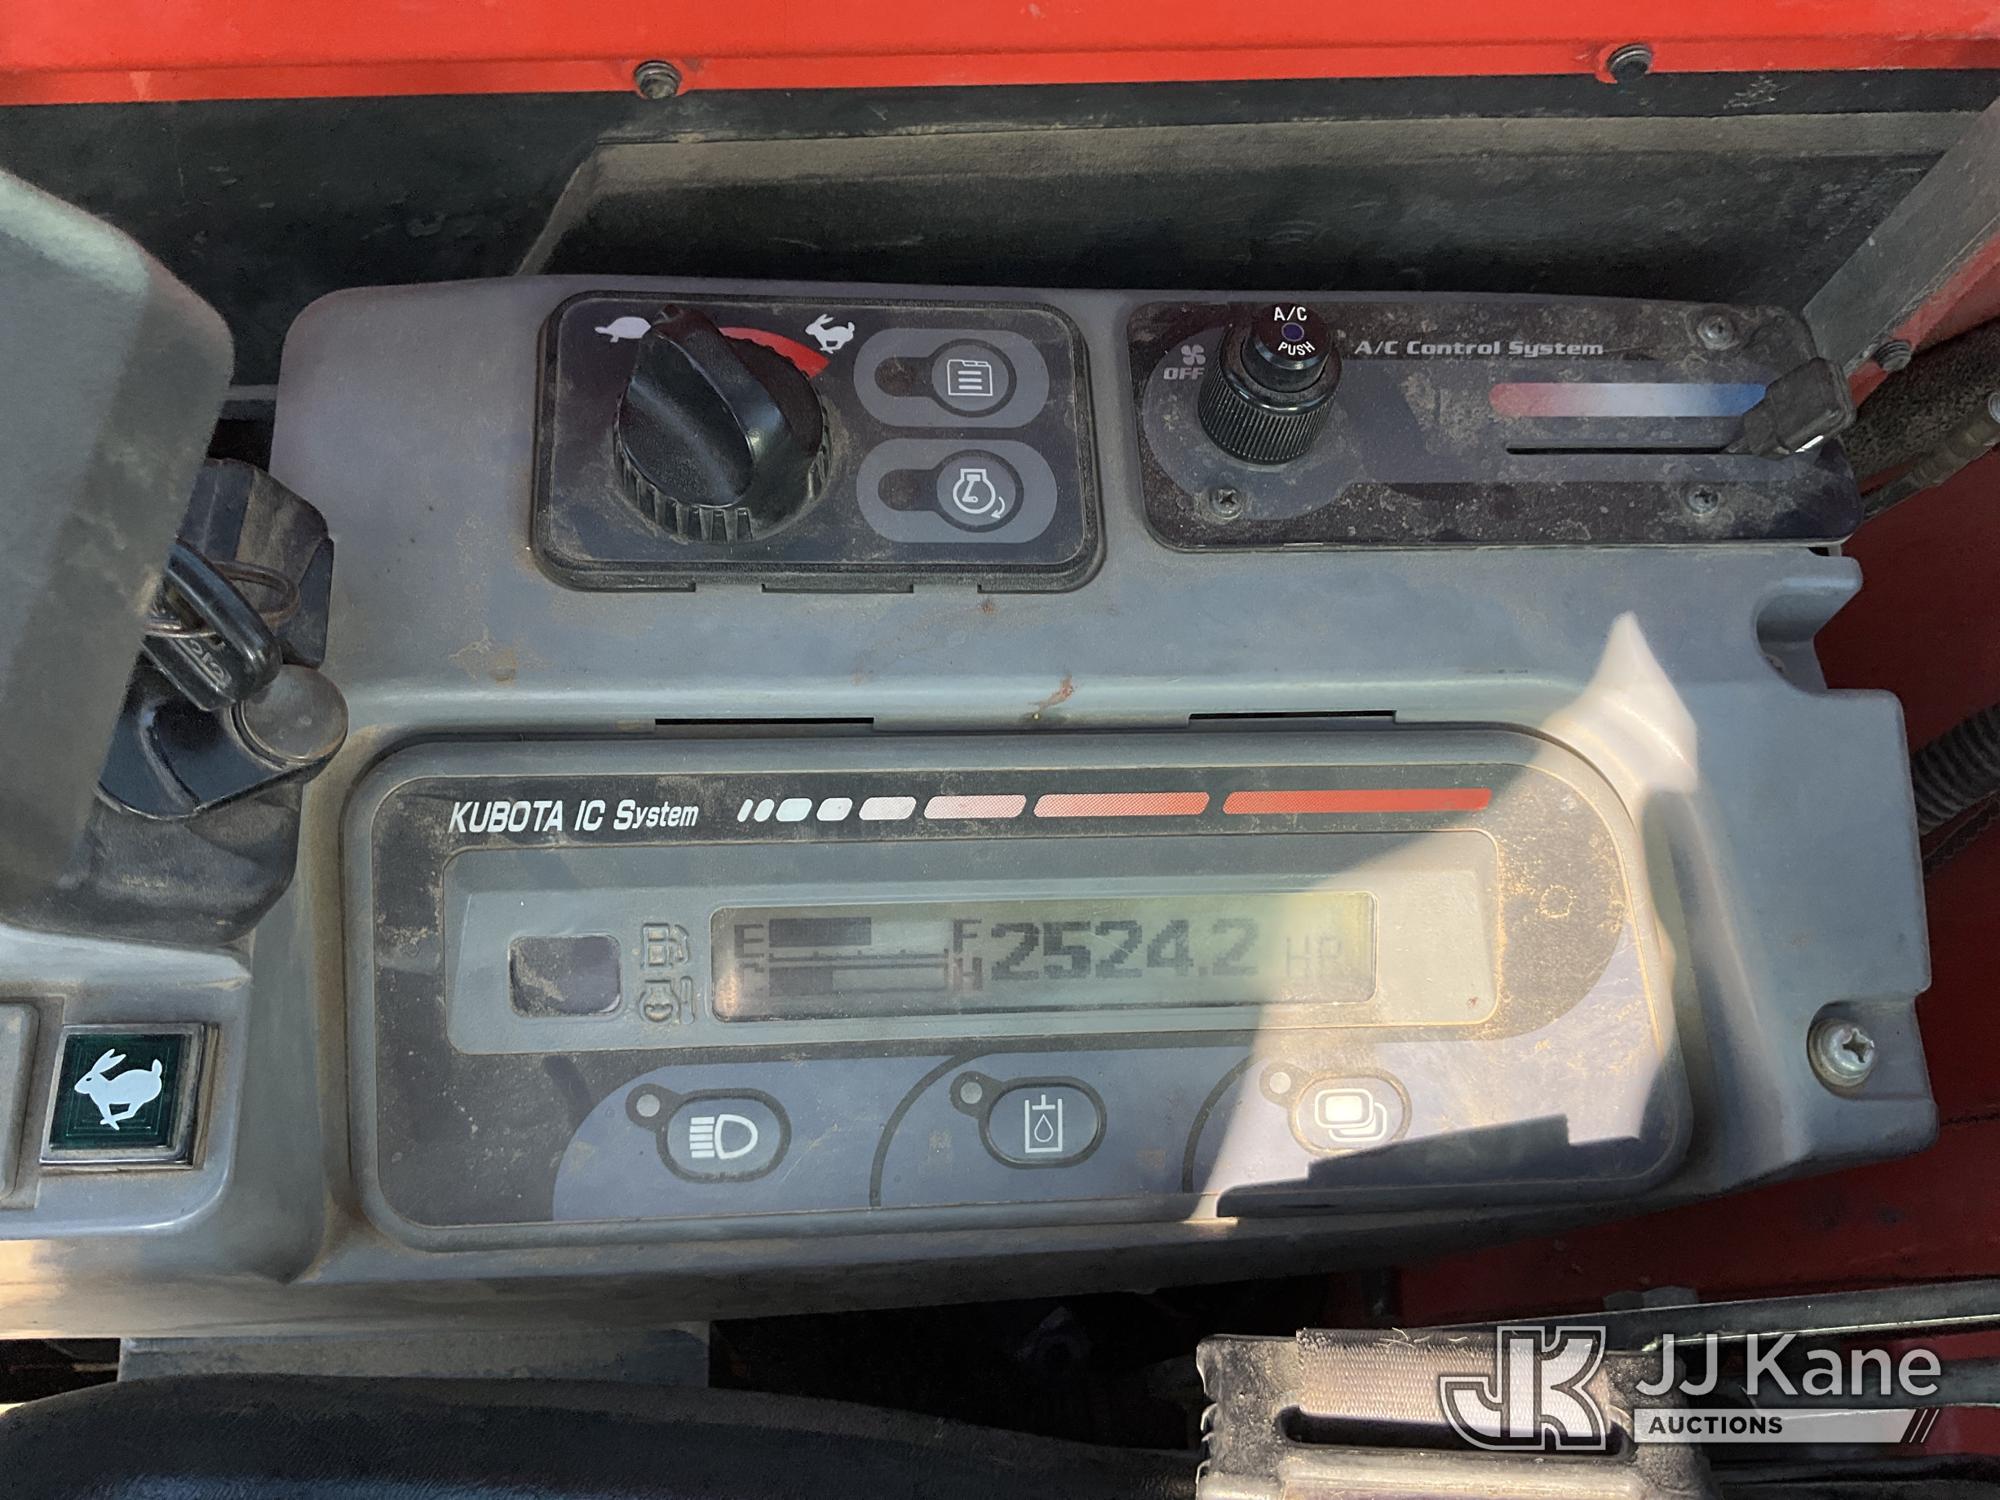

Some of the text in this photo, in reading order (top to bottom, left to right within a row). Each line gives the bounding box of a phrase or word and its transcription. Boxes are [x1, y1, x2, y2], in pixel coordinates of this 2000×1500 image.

[1273, 306, 1308, 322] A/C
[1277, 340, 1316, 357] PUSH
[1354, 340, 1604, 358] A/C Control System
[1162, 366, 1206, 381] OFF
[447, 798, 700, 833] KUBOTA IC System
[734, 923, 765, 959] E
[952, 918, 983, 954] F
[991, 918, 1258, 981] 2524.2
